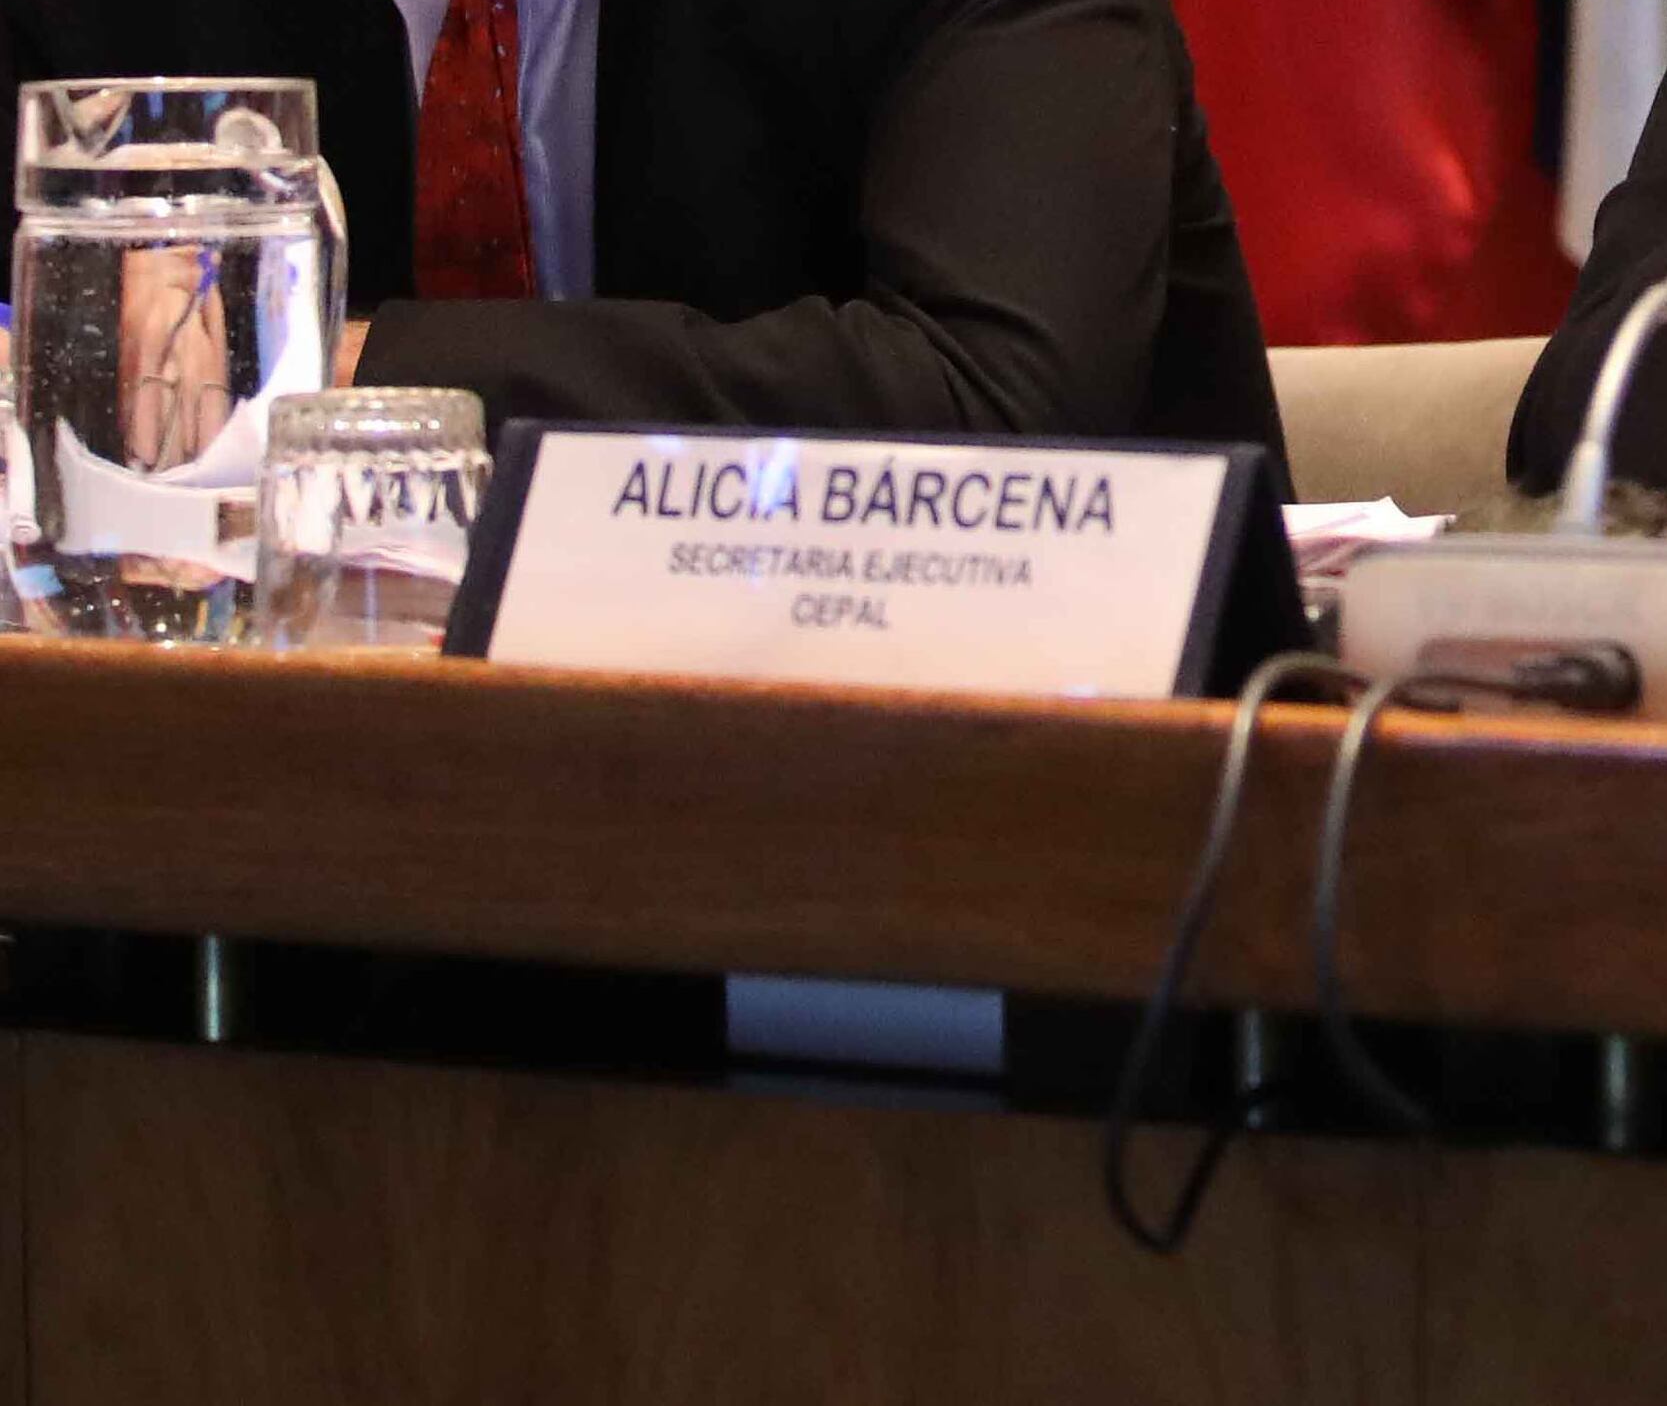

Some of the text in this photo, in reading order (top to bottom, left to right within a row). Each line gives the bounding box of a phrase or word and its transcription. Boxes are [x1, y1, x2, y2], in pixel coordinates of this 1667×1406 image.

[613, 455, 1115, 532] ALICIA BÁRCENA
[668, 543, 1032, 586] SECRETARIA EJECUTIVA
[790, 593, 888, 630] CEPAL
